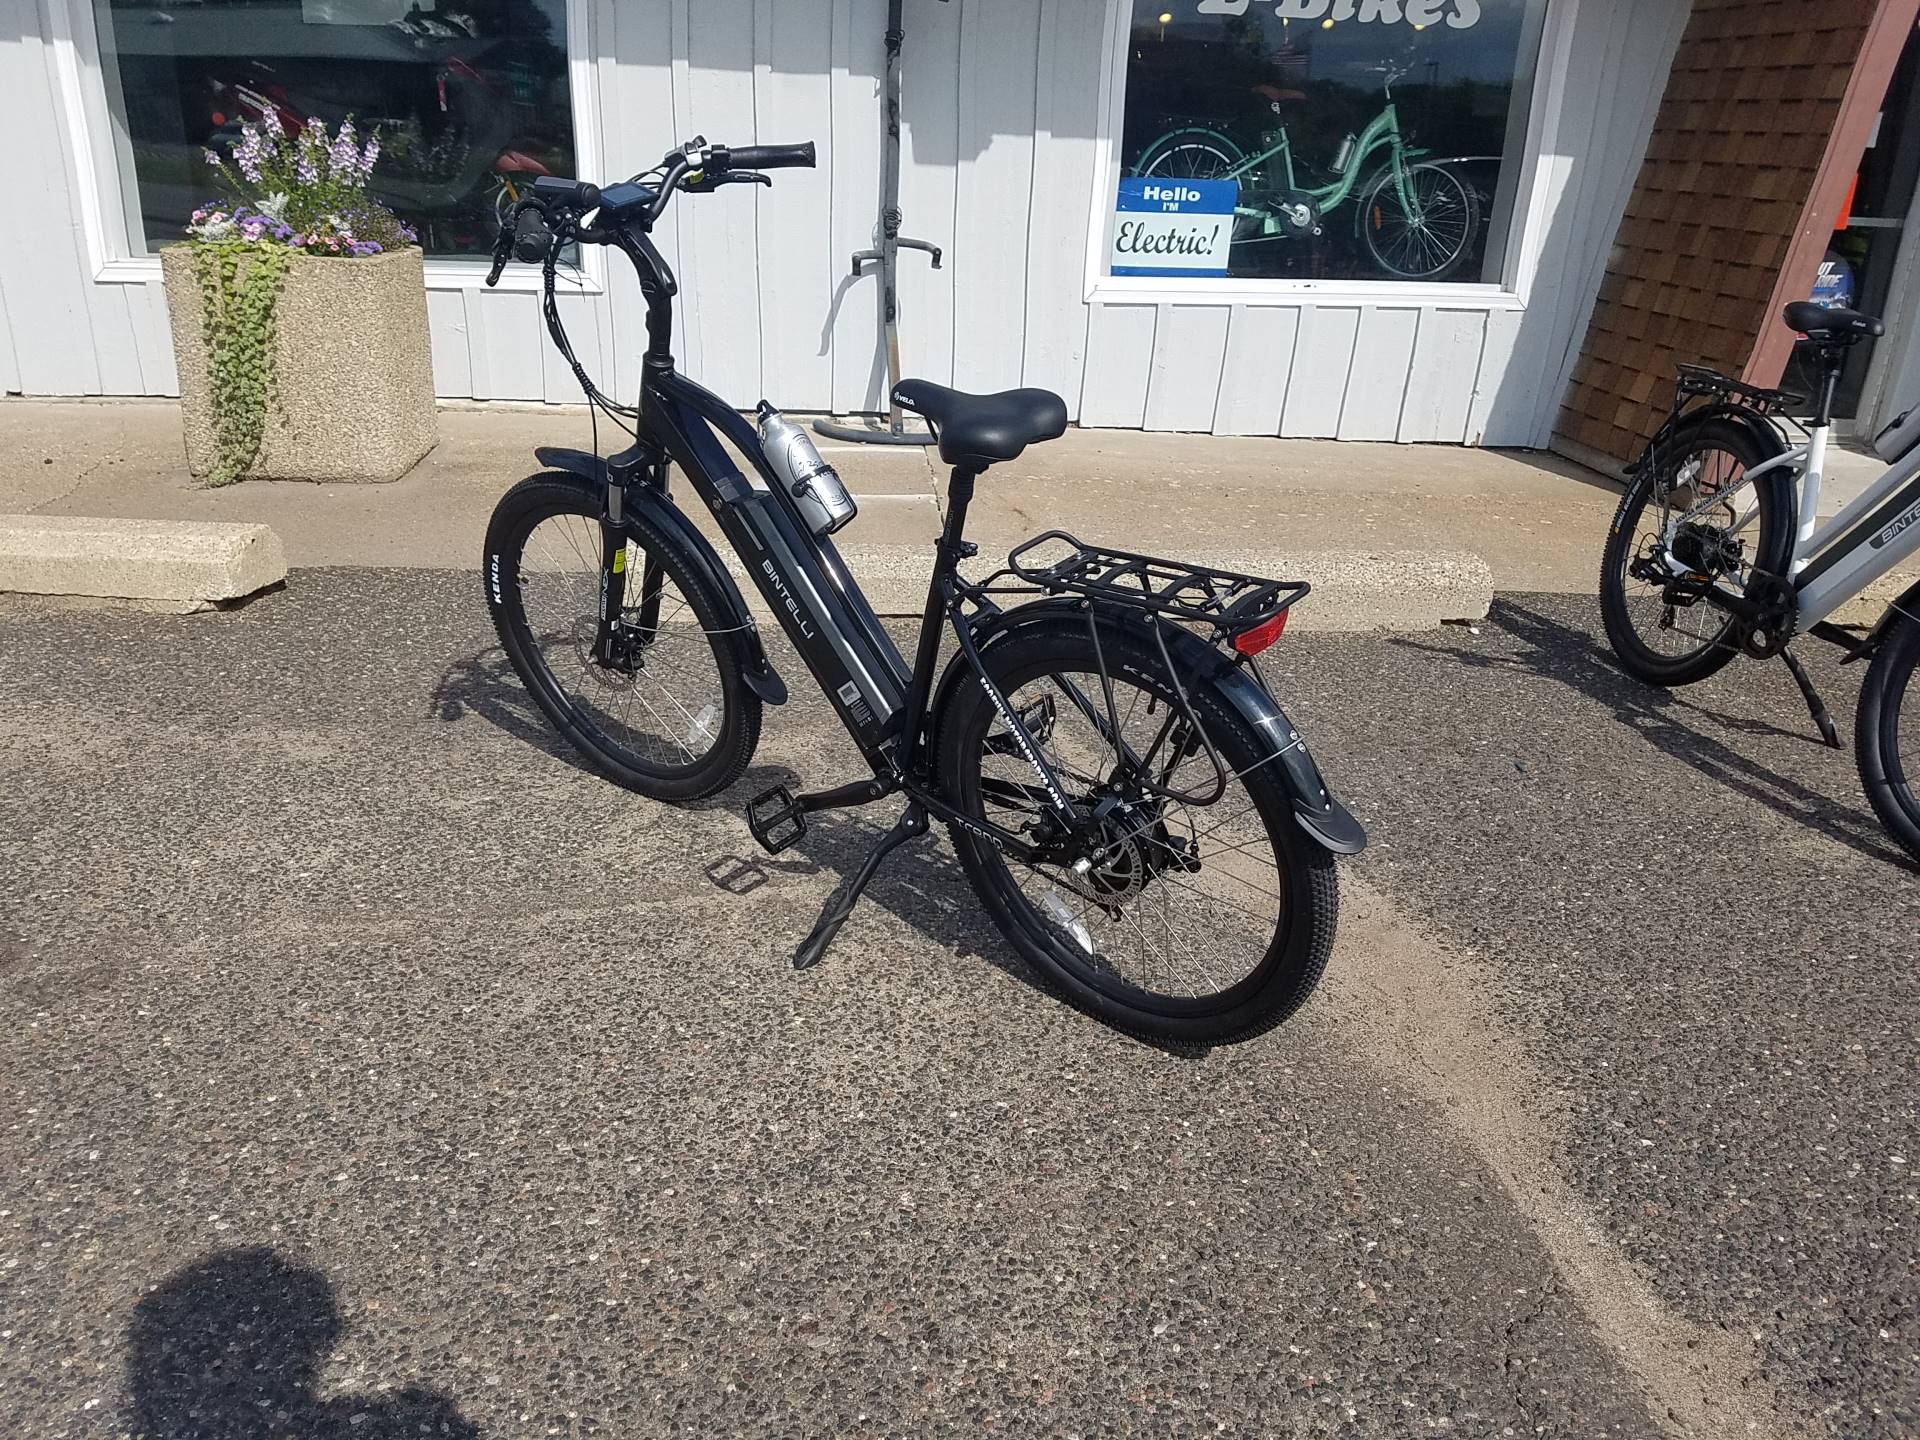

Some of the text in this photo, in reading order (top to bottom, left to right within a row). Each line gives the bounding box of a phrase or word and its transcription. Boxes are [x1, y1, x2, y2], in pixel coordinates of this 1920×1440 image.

[1197, 0, 1480, 29] ikes
[1143, 185, 1201, 201] Hello
[1162, 202, 1179, 211] I'M
[1115, 221, 1219, 255] Electric!
[491, 554, 502, 604] KENDA
[762, 559, 815, 640] BINTELLI
